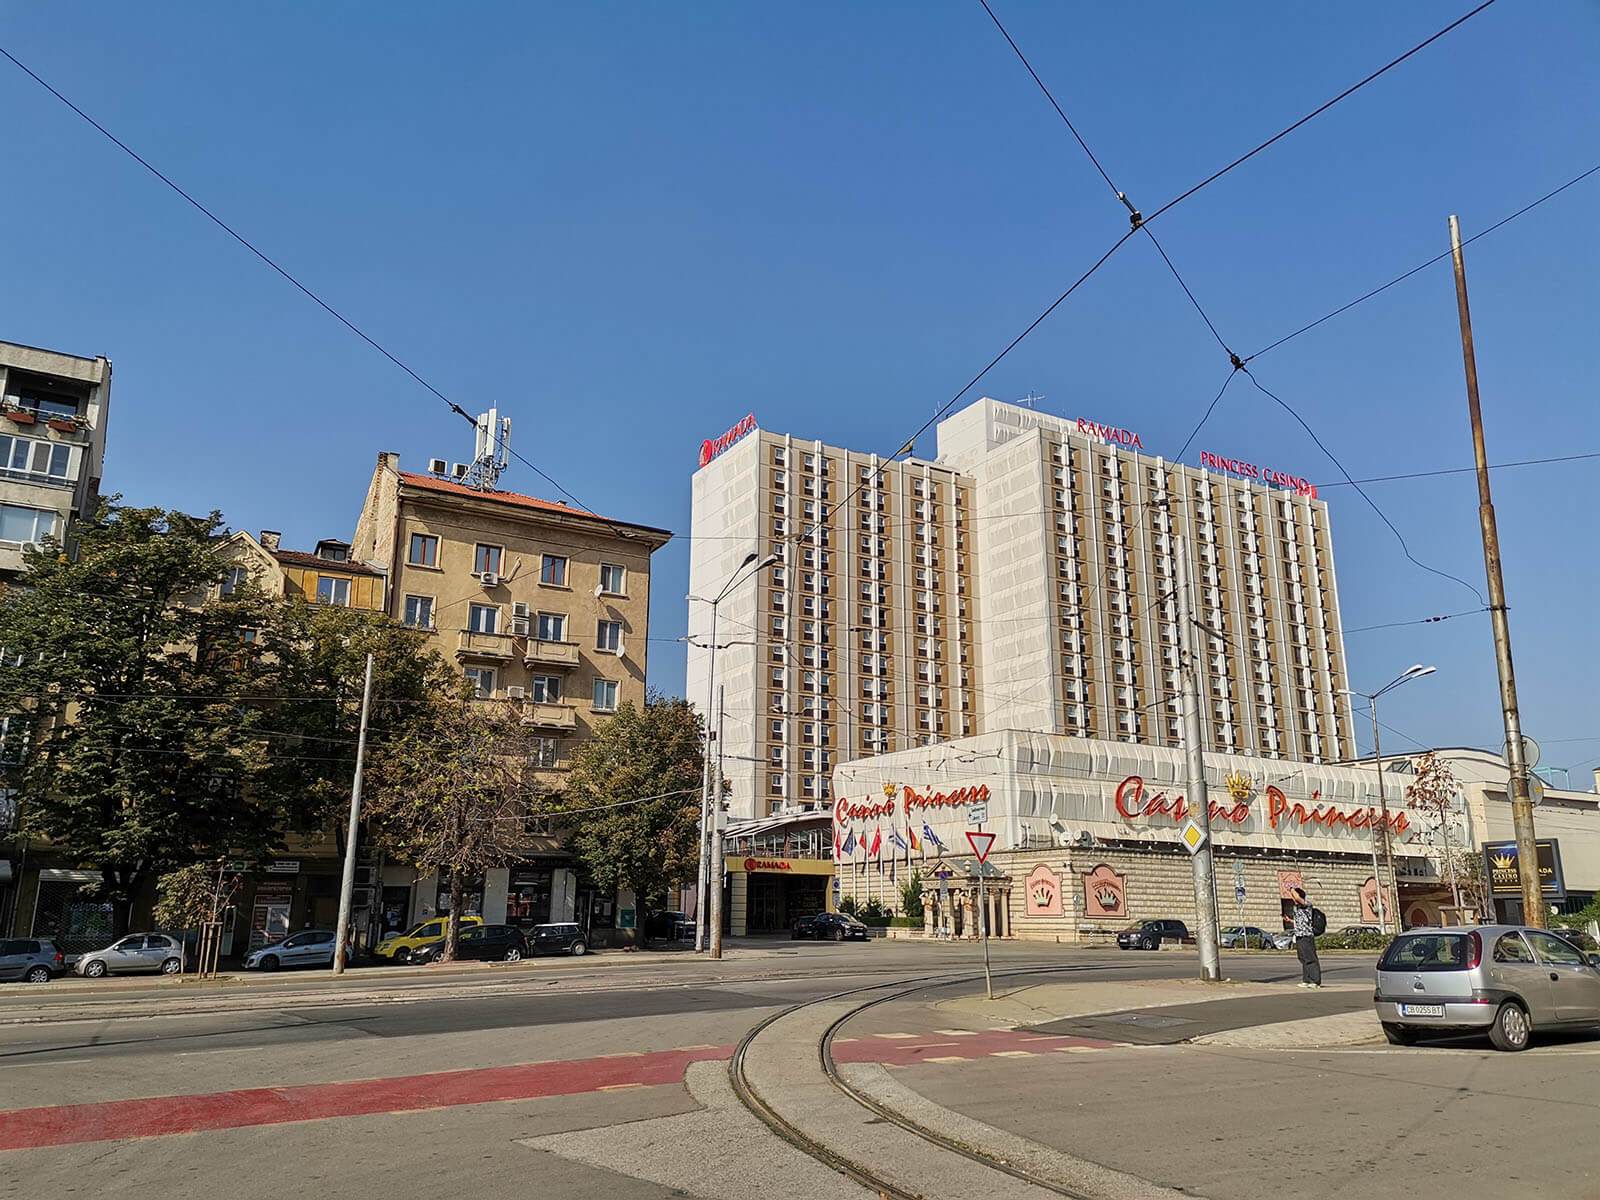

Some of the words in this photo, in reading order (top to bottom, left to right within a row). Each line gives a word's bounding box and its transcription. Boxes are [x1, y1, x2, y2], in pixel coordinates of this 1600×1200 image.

[1077, 417, 1143, 449] RAMADA
[1200, 451, 1259, 479] PRINCESS
[1263, 468, 1309, 490] CASINO
[836, 796, 896, 826] Casino
[902, 783, 988, 815] Princess
[1115, 775, 1250, 823] Casno
[1266, 785, 1411, 834] Princess
